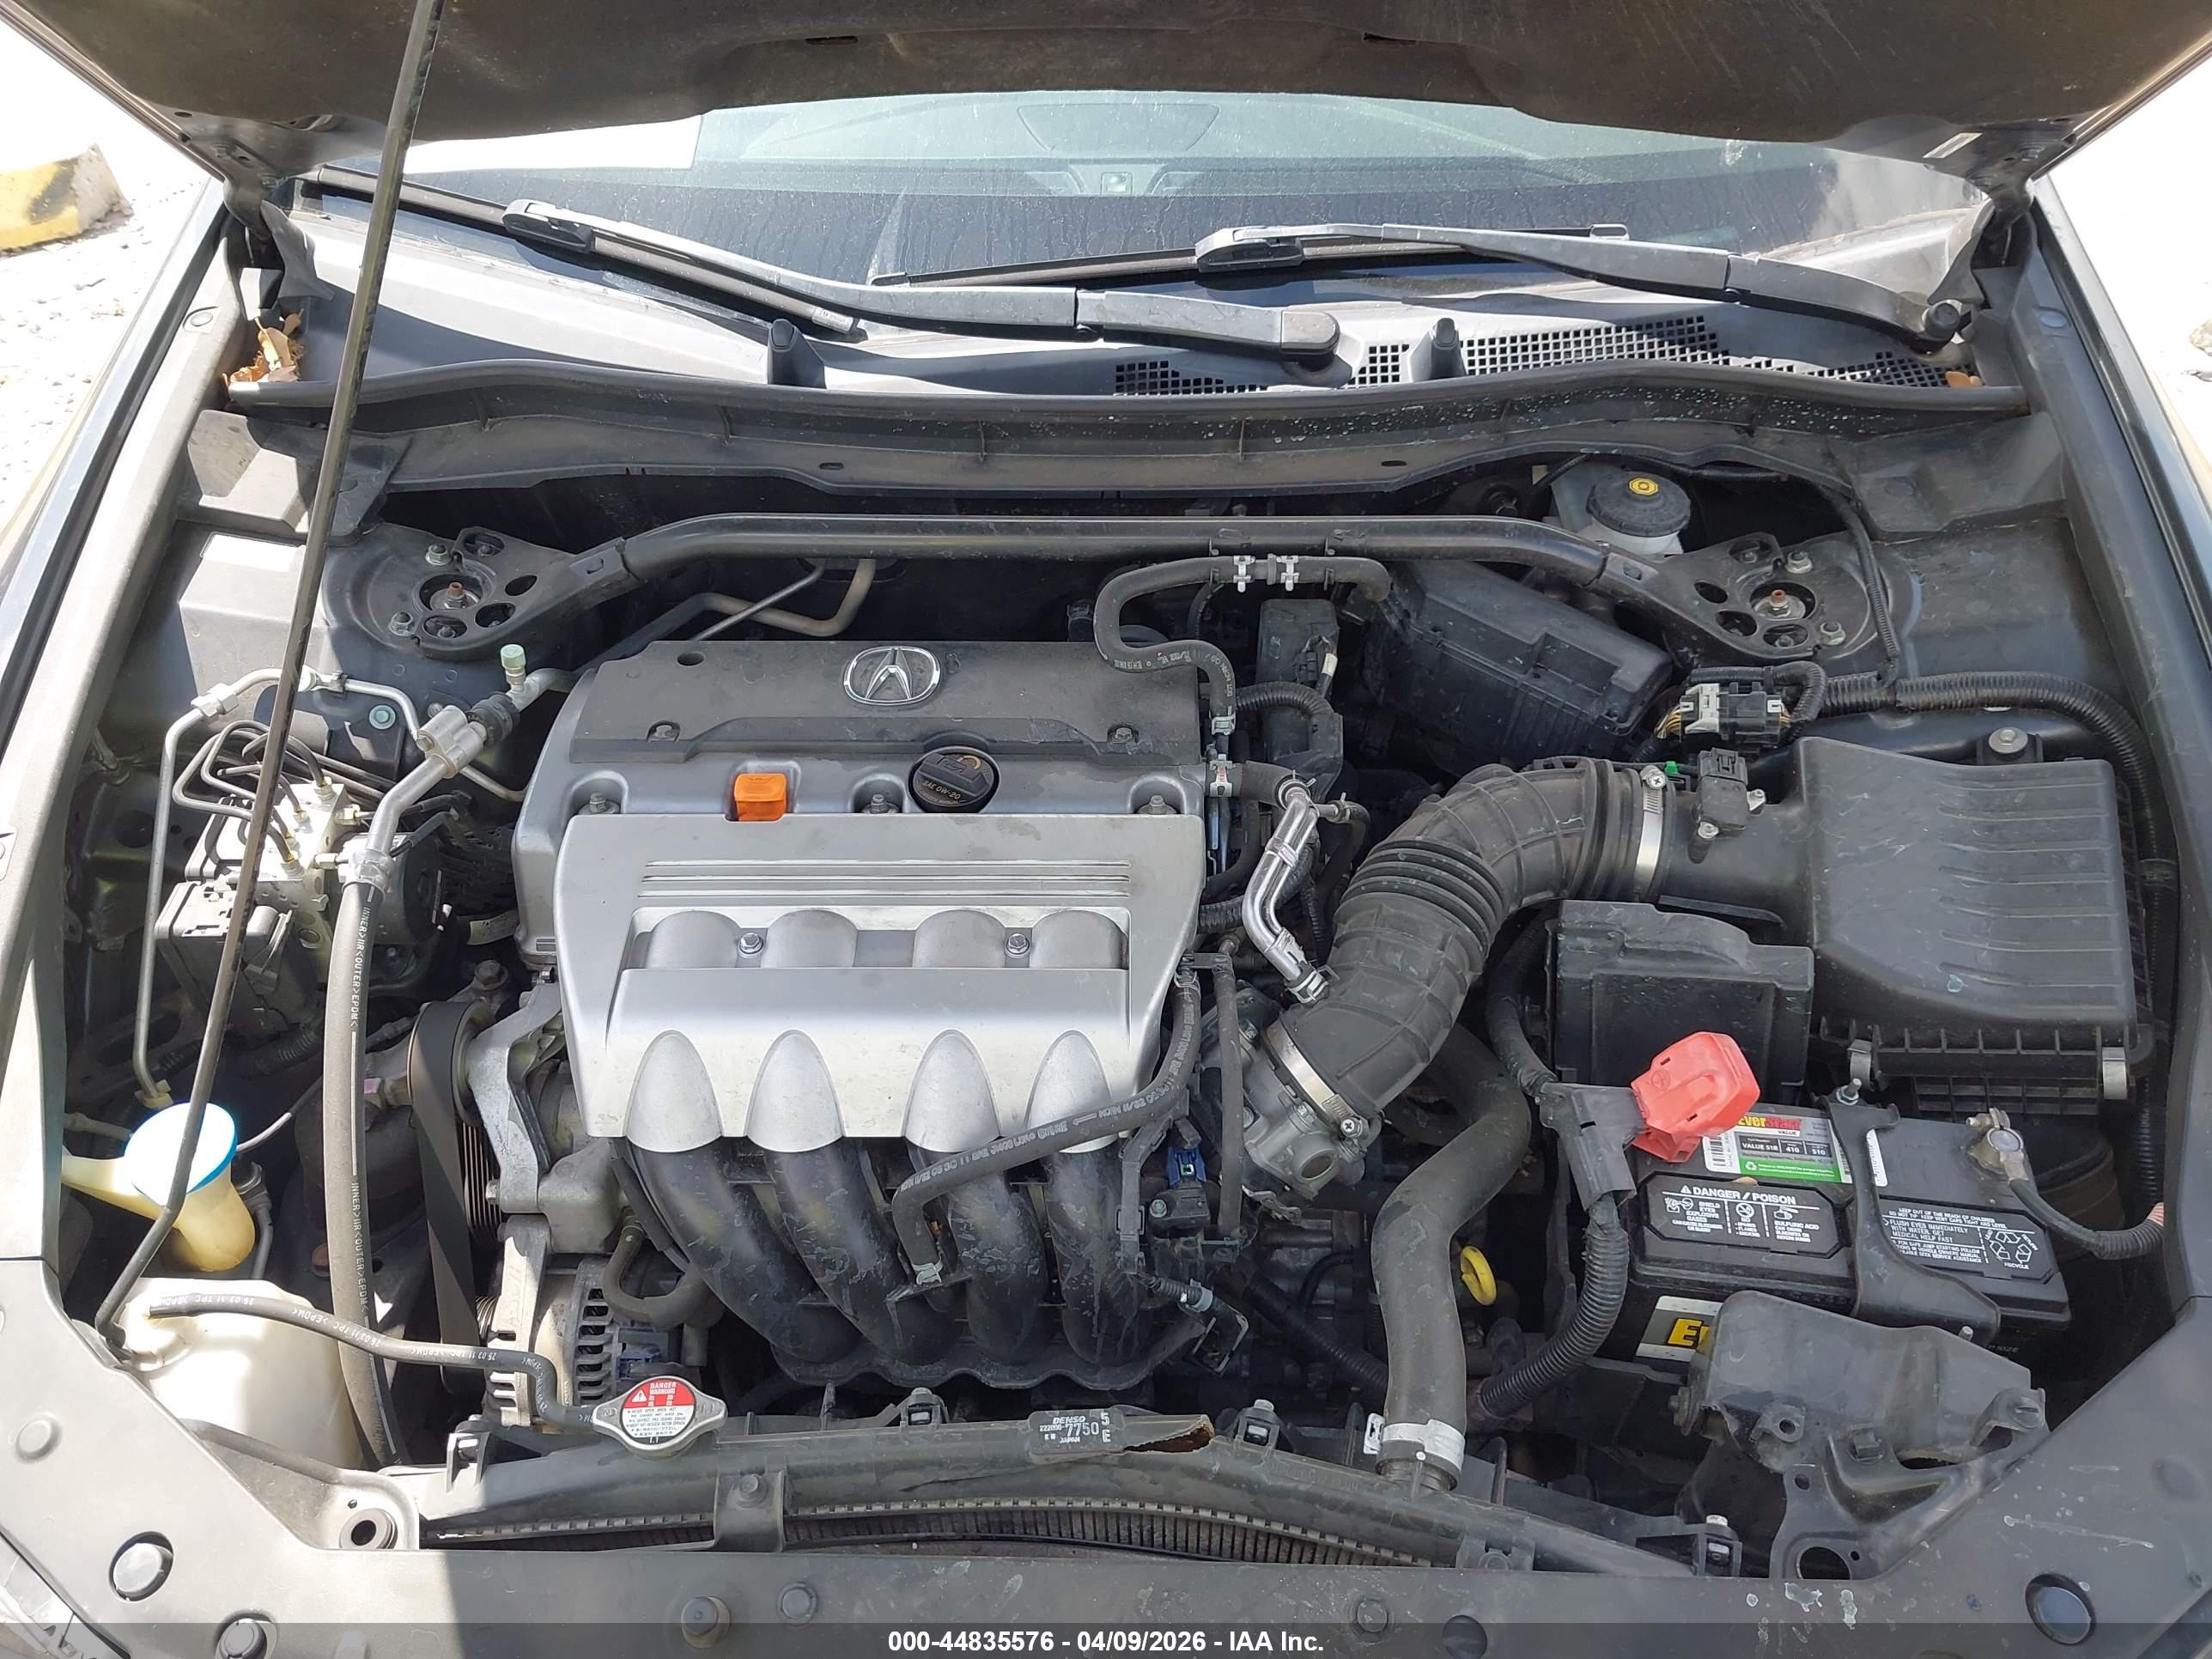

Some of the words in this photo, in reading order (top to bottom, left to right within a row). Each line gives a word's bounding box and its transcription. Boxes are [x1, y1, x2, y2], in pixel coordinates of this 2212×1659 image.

[922, 781, 936, 790] SAE
[1692, 1187, 1741, 1200] DANGER
[1752, 1193, 1796, 1205] POISON
[1928, 1224, 1968, 1234] IMMEDIATELY
[2004, 1261, 2029, 1270] RECYCLE
[1053, 1416, 1085, 1425] DENSO
[1100, 1413, 1110, 1425] 5
[1102, 1430, 1111, 1443] E
